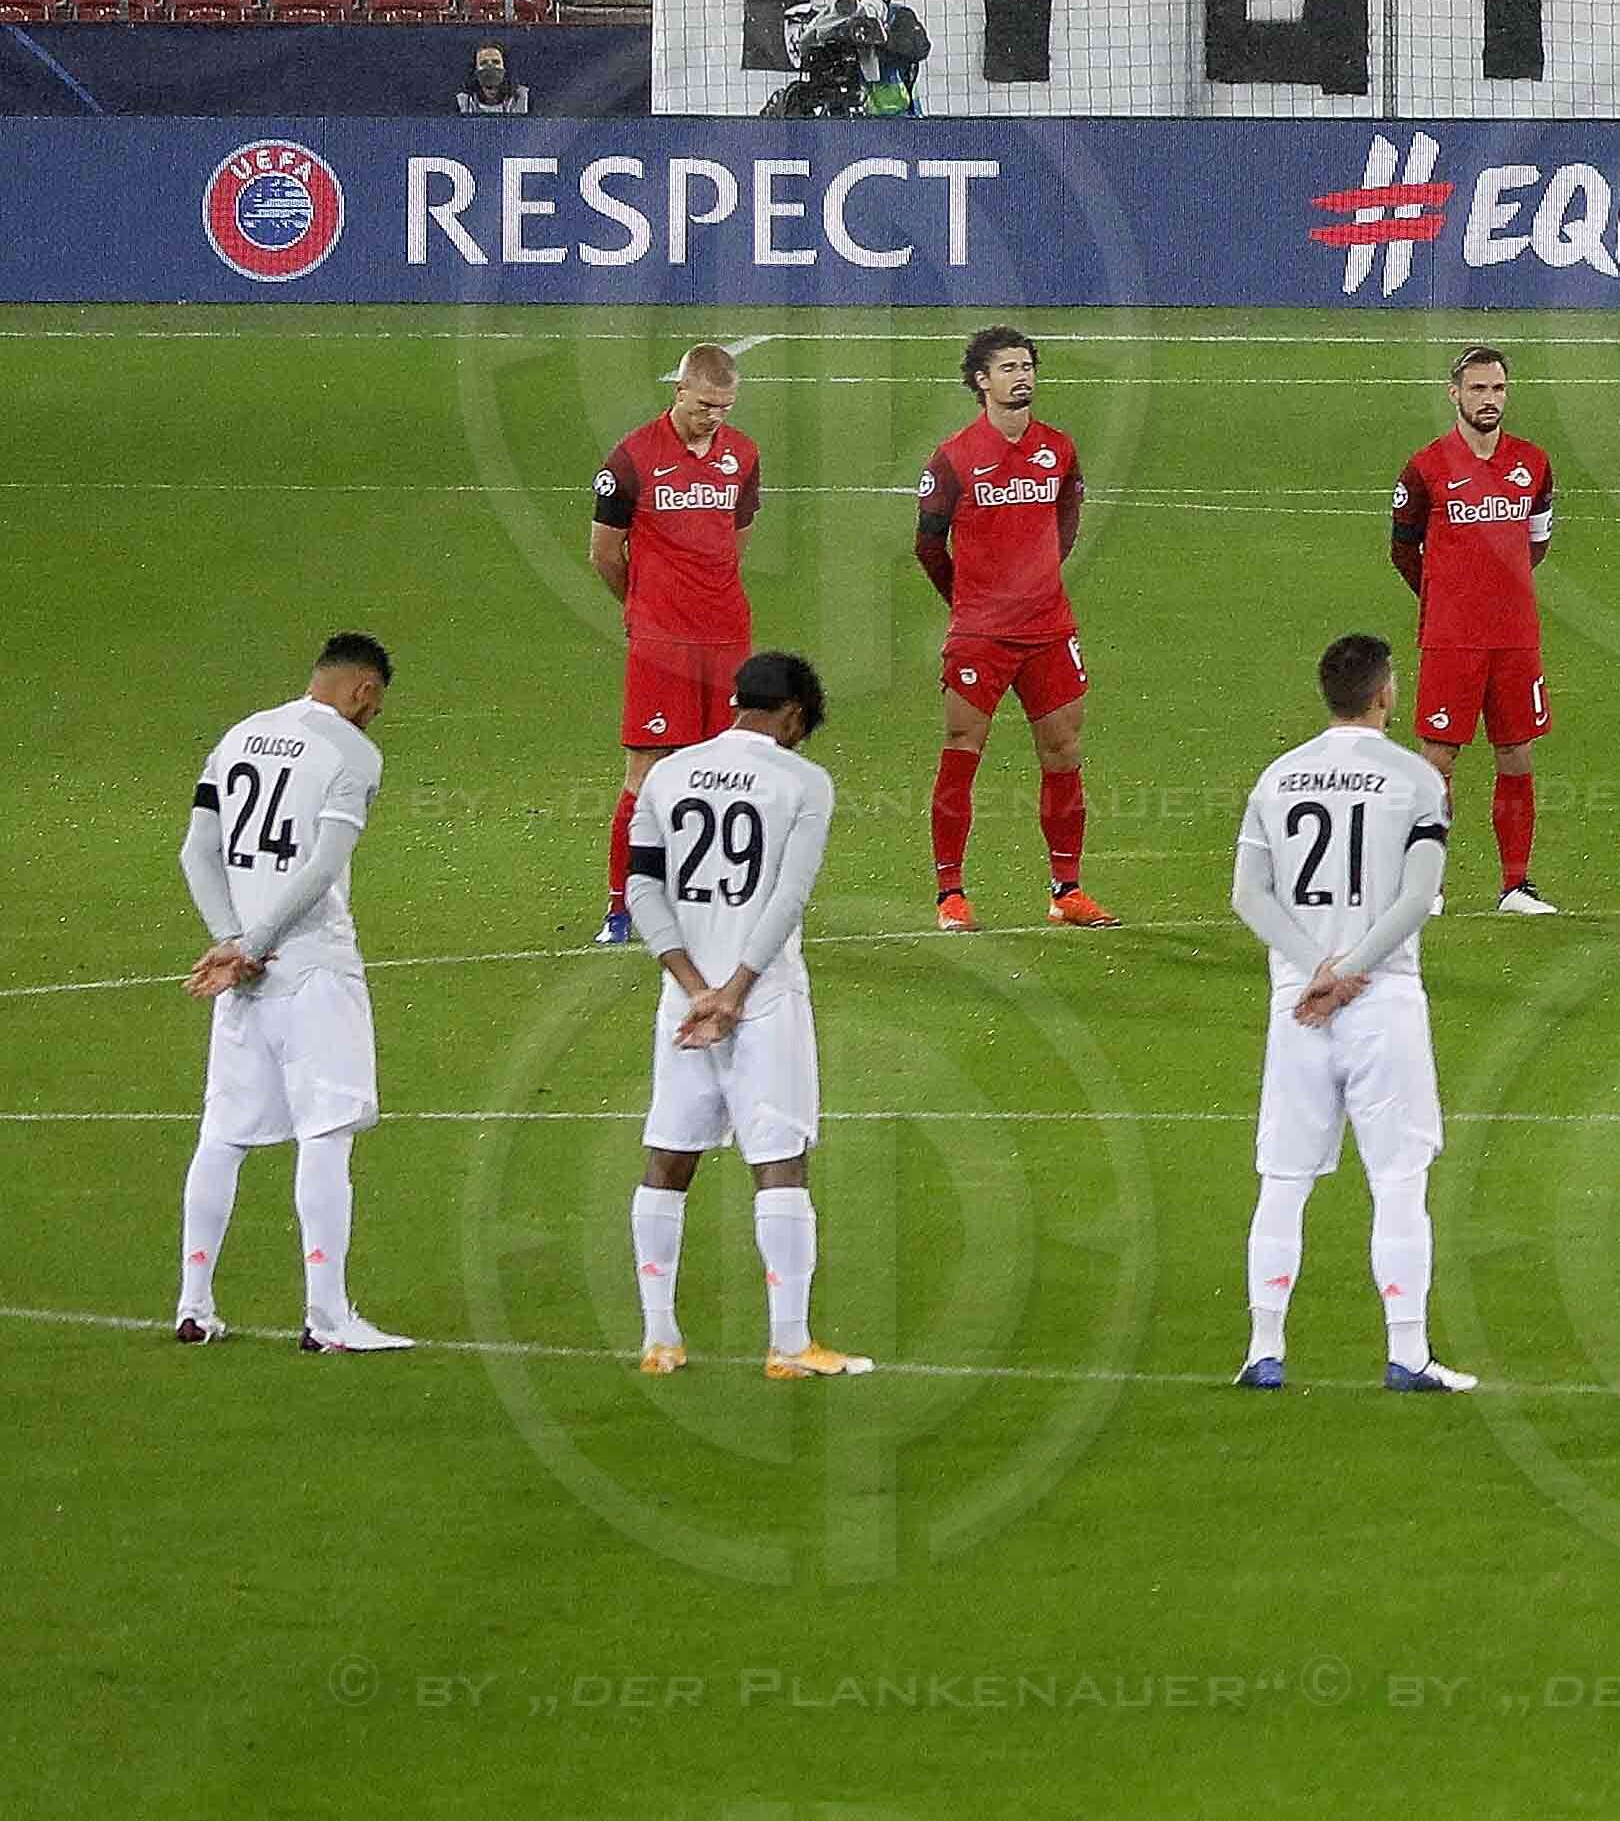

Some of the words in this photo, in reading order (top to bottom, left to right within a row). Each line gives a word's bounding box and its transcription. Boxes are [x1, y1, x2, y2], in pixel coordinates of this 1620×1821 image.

[230, 149, 312, 181] UEFA
[406, 156, 1002, 270] RESPECT
[242, 734, 306, 760] TOLISSO
[689, 768, 757, 794] COMAN
[1278, 767, 1388, 795] HERNÁNDEZ
[226, 762, 298, 872] 24
[670, 796, 764, 907] 29
[1286, 801, 1365, 907] 21
